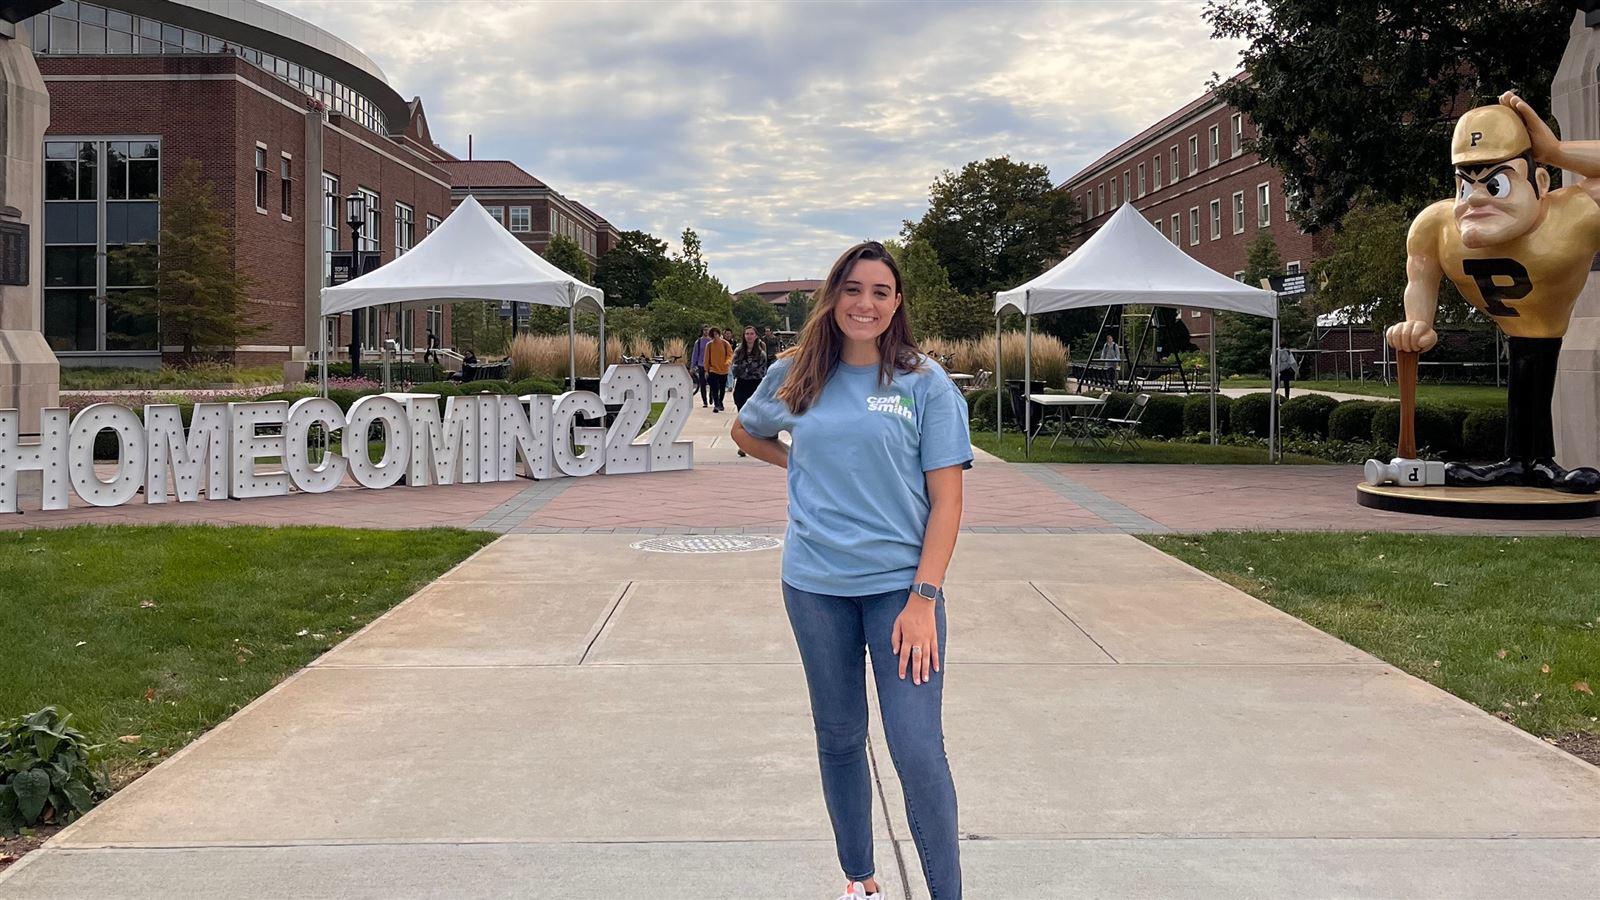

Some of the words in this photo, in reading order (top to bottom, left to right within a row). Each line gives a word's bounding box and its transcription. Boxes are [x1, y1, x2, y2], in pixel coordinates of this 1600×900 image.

[1470, 132, 1483, 147] P
[1462, 258, 1533, 317] P
[1408, 467, 1425, 482] P
